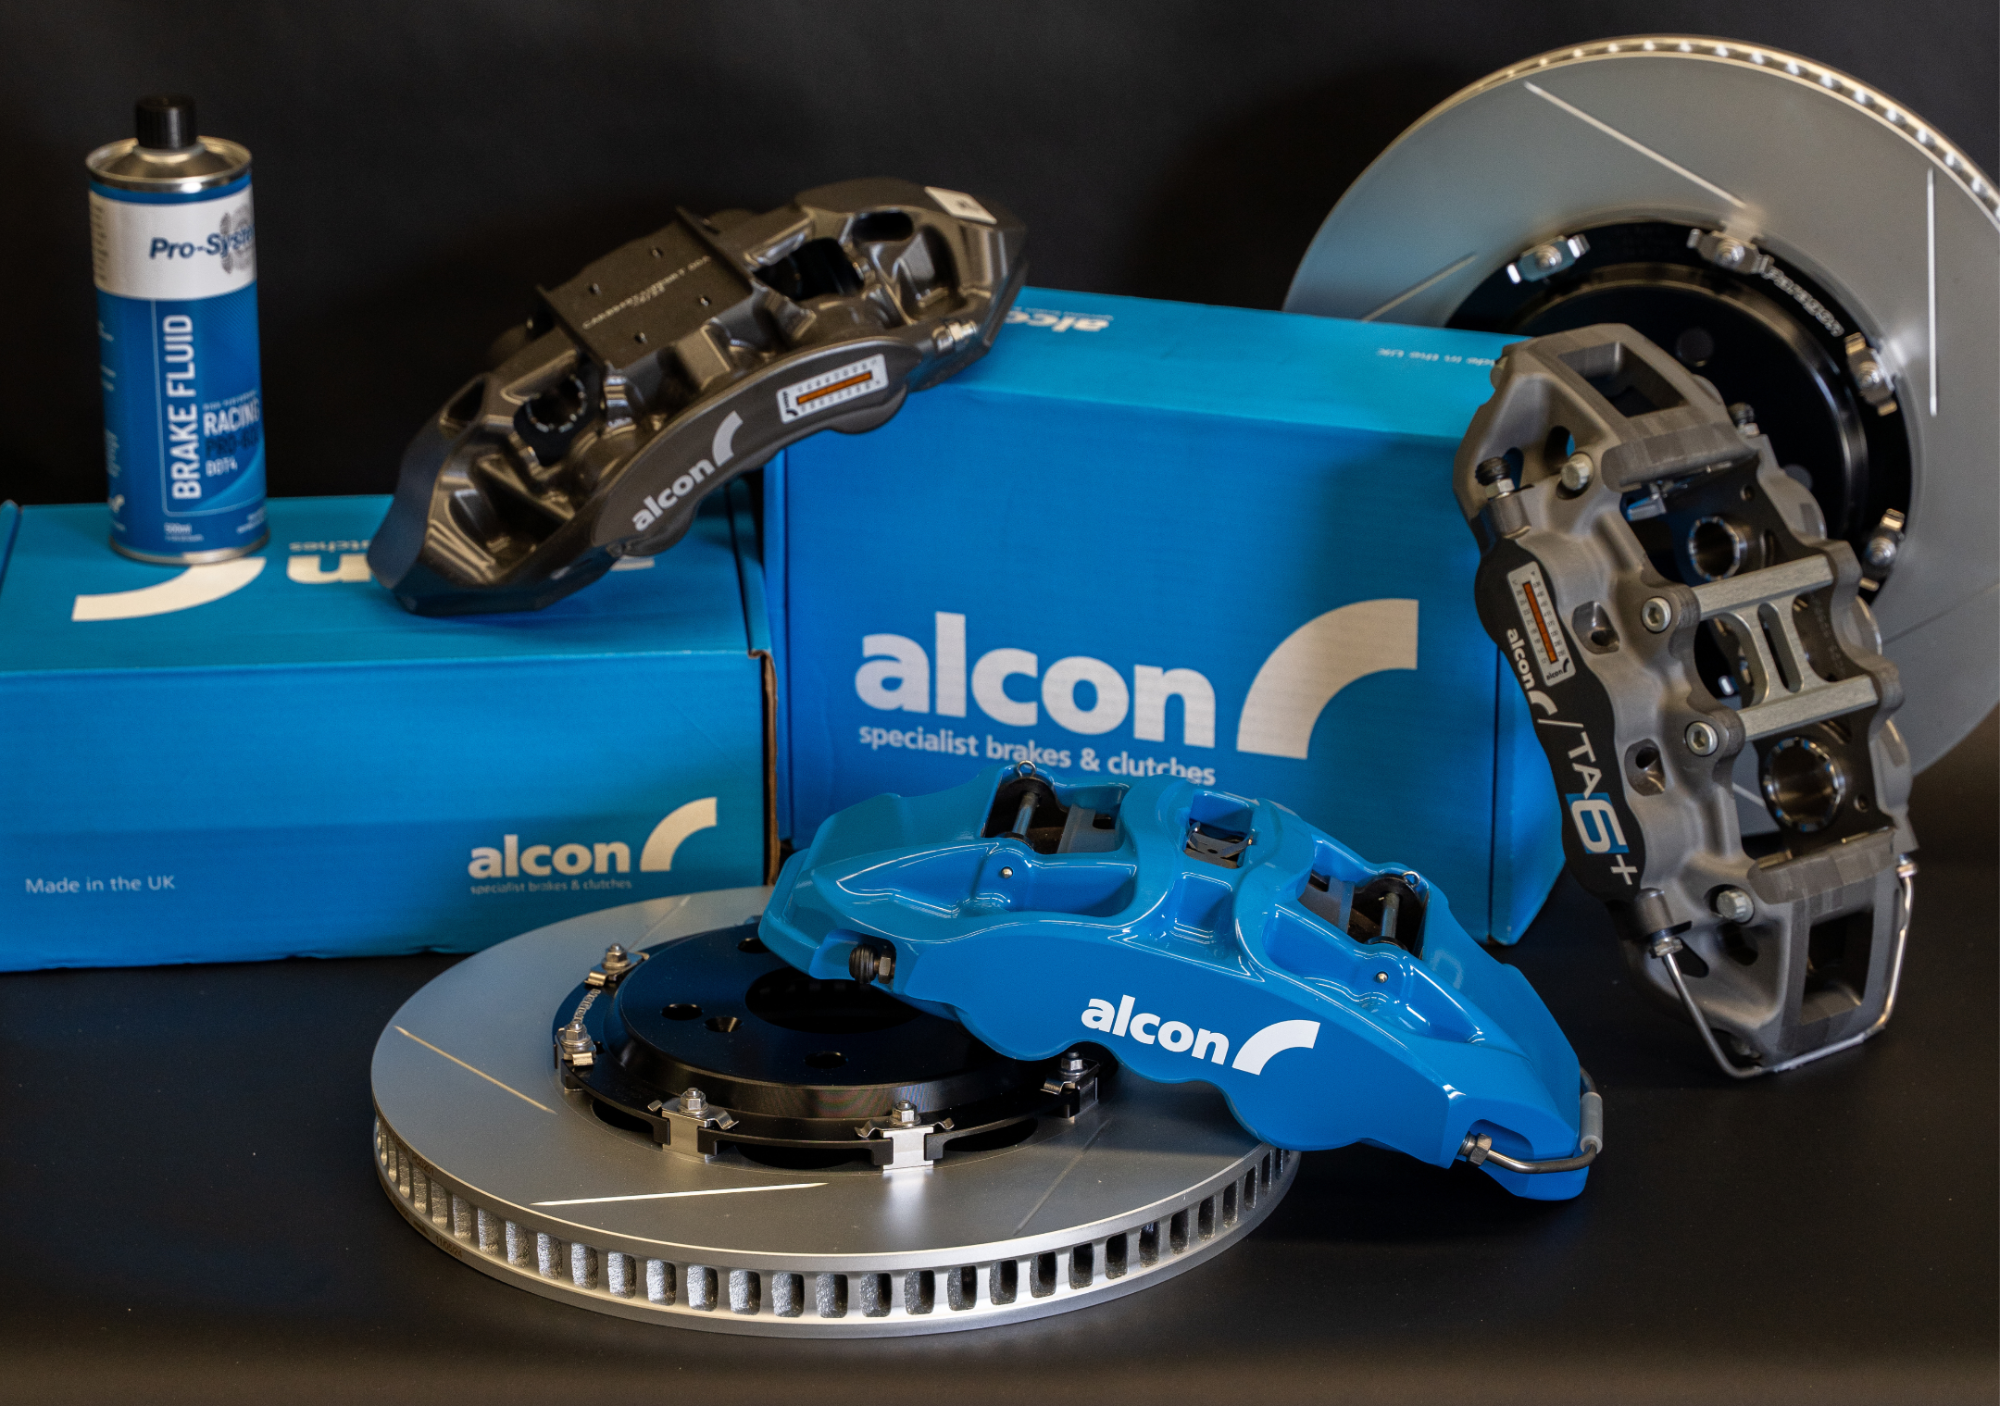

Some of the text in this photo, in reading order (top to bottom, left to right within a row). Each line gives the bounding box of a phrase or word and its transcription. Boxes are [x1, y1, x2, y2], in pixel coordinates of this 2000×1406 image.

[1004, 310, 1109, 333] alco
[163, 314, 197, 397] FLUID
[168, 403, 202, 499] BRAKE
[632, 459, 715, 531] alcon
[855, 611, 1216, 749] alcon
[1506, 628, 1536, 689] alcon
[859, 727, 979, 757] specialist
[986, 735, 1071, 768] brakes
[1079, 748, 1101, 772] &
[25, 875, 175, 893] Made in the UK
[468, 834, 631, 879] alcon
[470, 879, 632, 895] specialist brakes & clutches
[1081, 994, 1229, 1066] alcon
